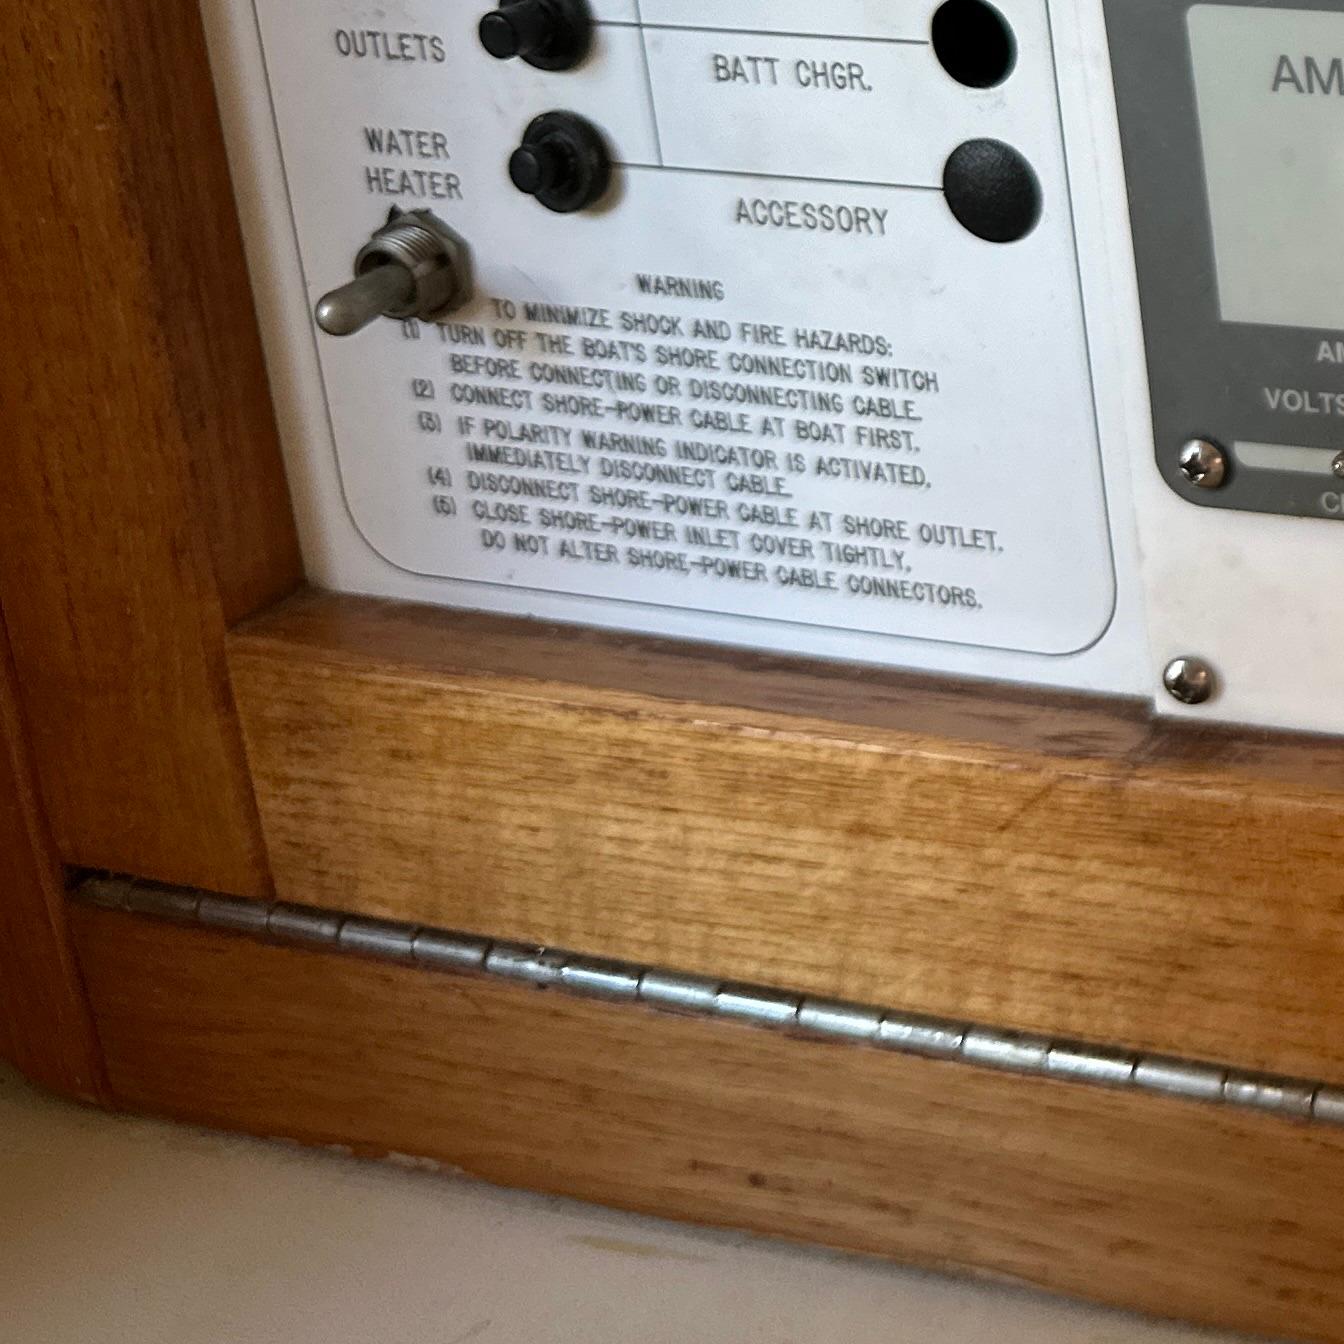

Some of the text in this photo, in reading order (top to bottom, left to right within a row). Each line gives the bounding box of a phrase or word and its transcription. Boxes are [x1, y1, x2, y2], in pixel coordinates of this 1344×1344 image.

[336, 30, 446, 64] OUTLETS
[713, 55, 873, 92] BATT CHGR.
[365, 127, 450, 162] WATER
[366, 169, 464, 202] HEATER
[737, 198, 888, 236] ACCESSORY
[636, 273, 724, 300] WARNING
[492, 297, 516, 320] TO
[525, 302, 612, 330] MINIMIZE
[621, 309, 684, 336] SHOCK
[693, 317, 731, 340] AND
[740, 322, 785, 346] FIRE
[438, 322, 939, 392] TURN OFF THE SHORE CONNECTION SWITCH
[450, 353, 843, 413] BEFORE CONNECTING OR DISCONNECTING
[452, 383, 920, 452] CONNECT SHORE-POWER AT BOAT FIRST.
[459, 416, 931, 488] IF POLARITY WARNING INDICATOR IS ACTIVATED.
[466, 441, 716, 489] IMMEDIATELY DISCONNECT
[466, 470, 1004, 552] DISCONNECT SHORE-POWER AT SHORE OUTLET.
[472, 500, 530, 524] CLOSE
[539, 508, 675, 541] SHORE-POWER
[684, 525, 740, 549] INLET
[749, 532, 815, 558] COVER
[481, 528, 983, 608] DO NOT ALTER SHORE-POWER CONNECTORS.
